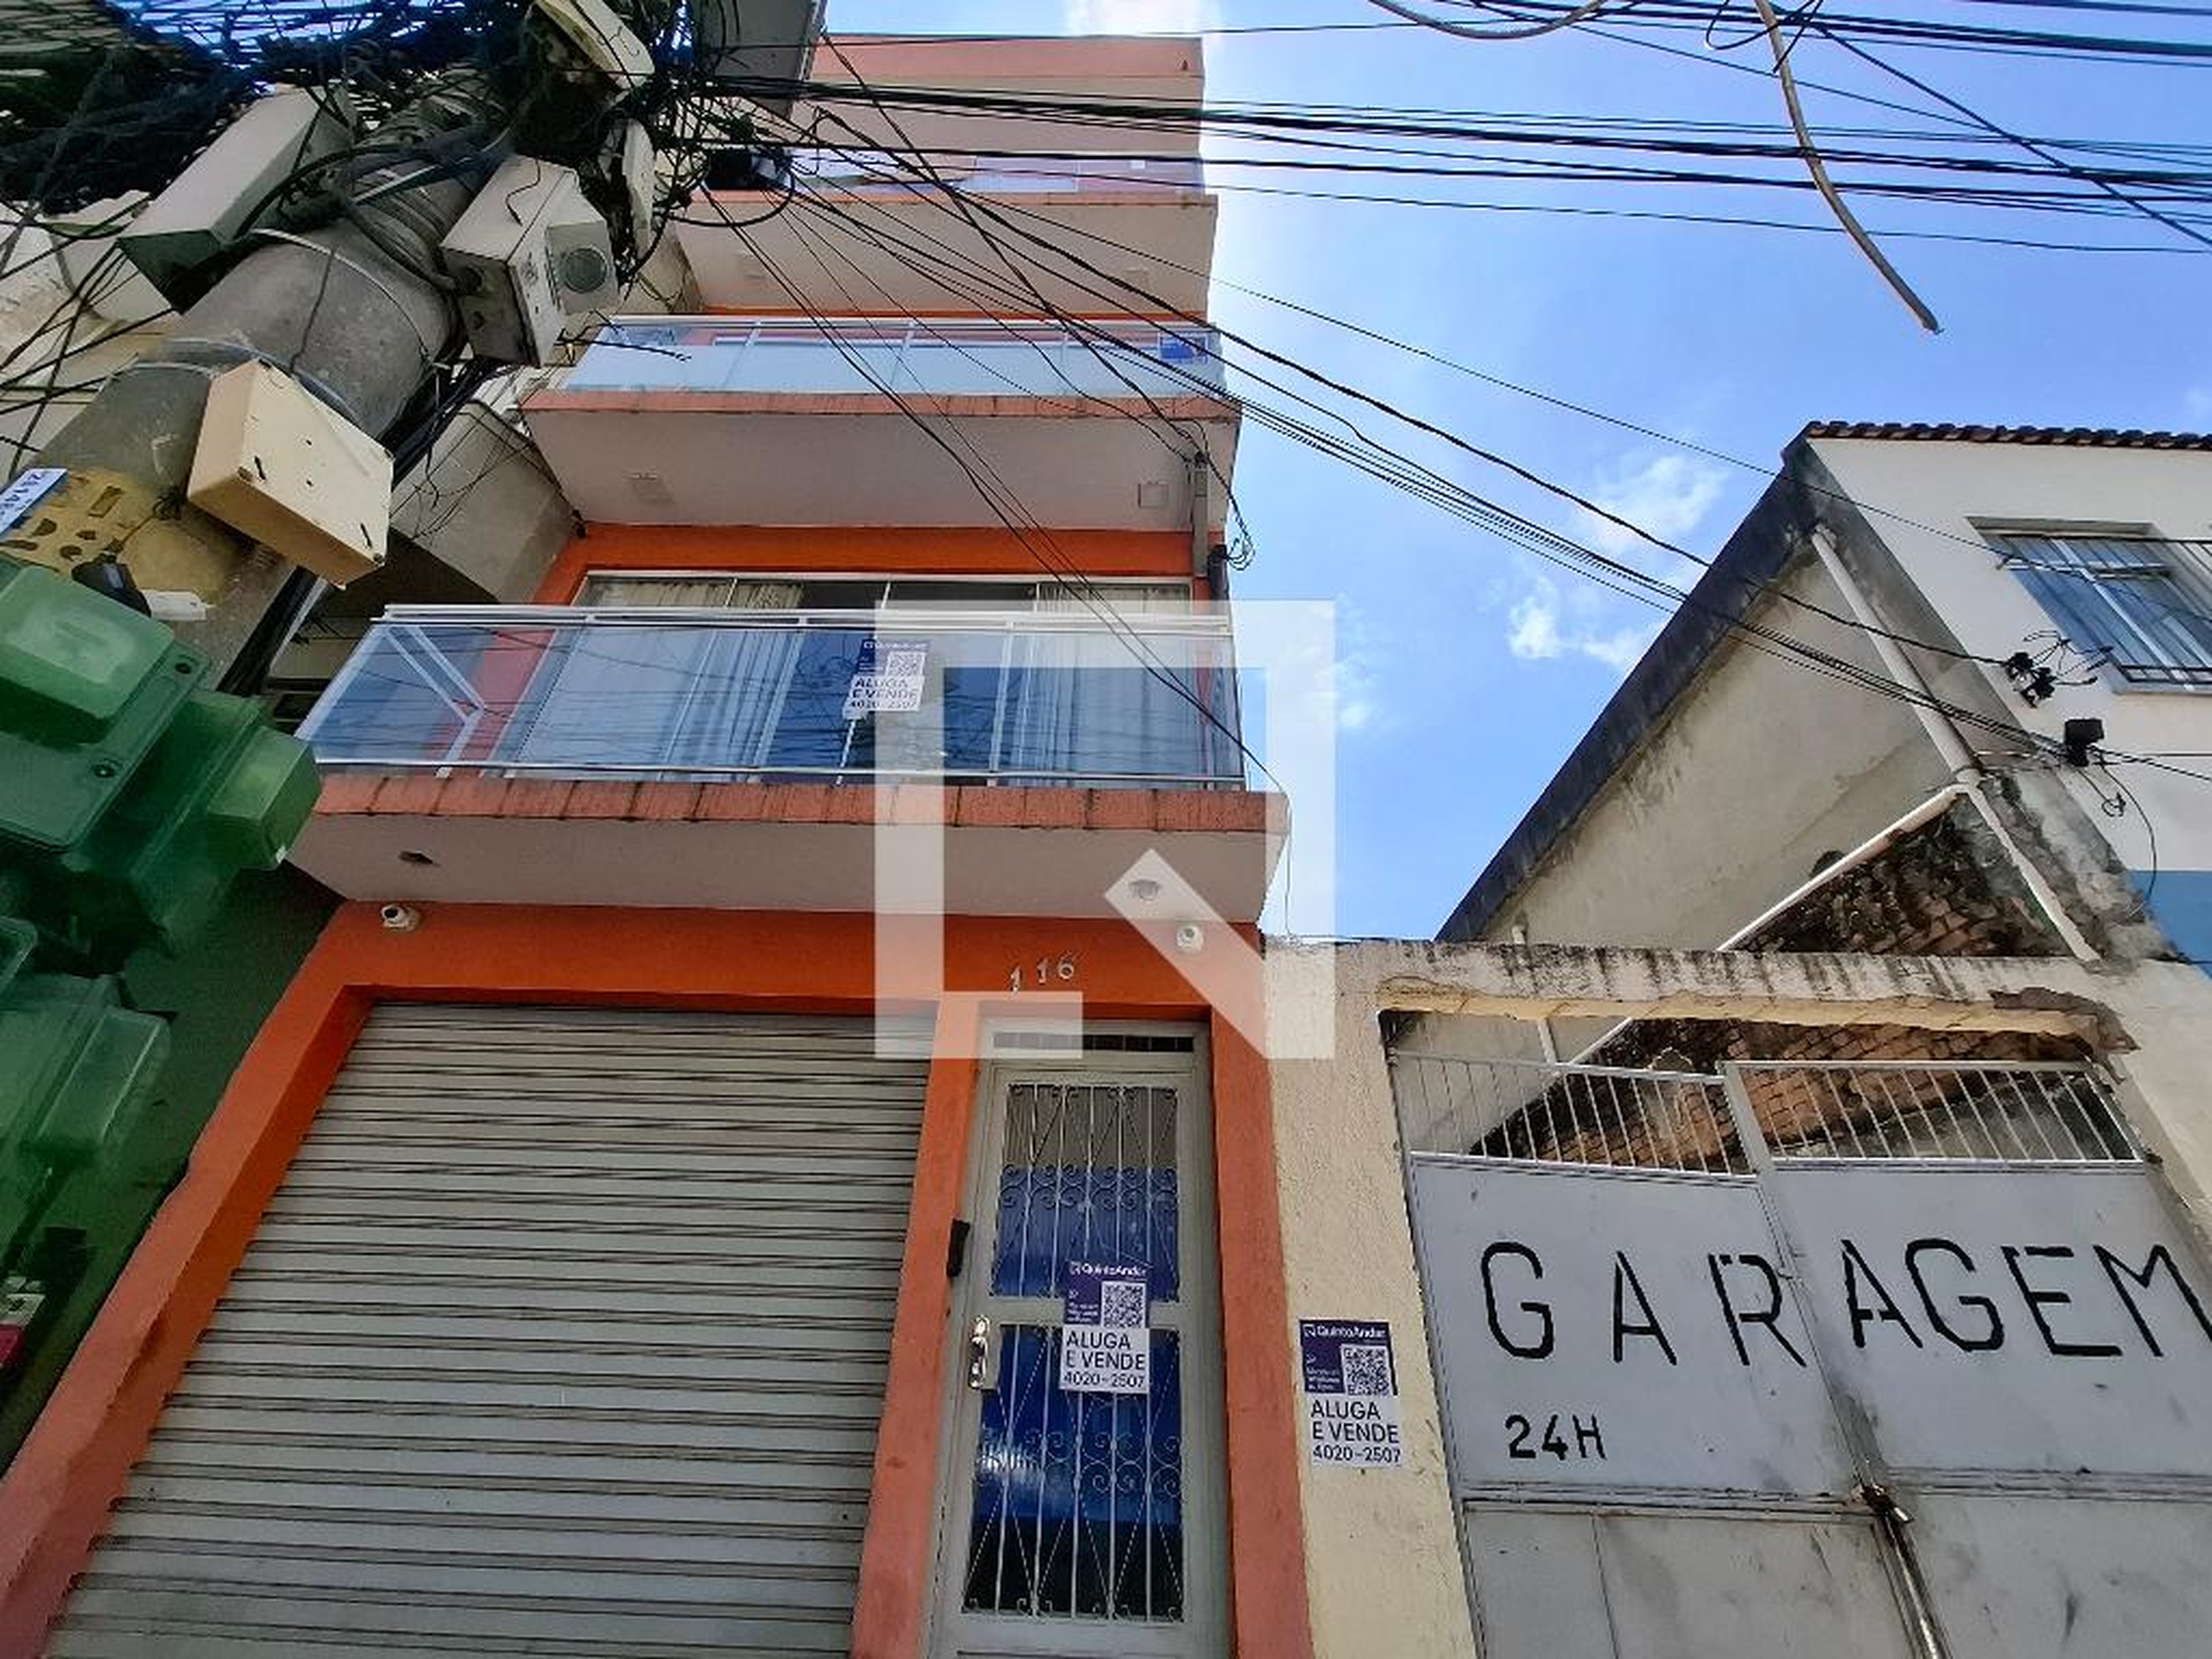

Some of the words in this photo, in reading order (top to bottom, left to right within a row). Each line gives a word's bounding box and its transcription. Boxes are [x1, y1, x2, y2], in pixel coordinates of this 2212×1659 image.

[1010, 952, 1074, 999] 116
[1481, 1239, 2212, 1366] GARAGEM
[1066, 1331, 1131, 1350] ALUGA
[1067, 1350, 1075, 1368] E
[1082, 1352, 1146, 1370] VENDE
[1310, 1399, 1381, 1419] ALUGA
[1313, 1422, 1324, 1440] E
[1328, 1423, 1400, 1444] VENDE
[1505, 1414, 1607, 1460] 24H
[1313, 1445, 1401, 1463] 4020-2507
